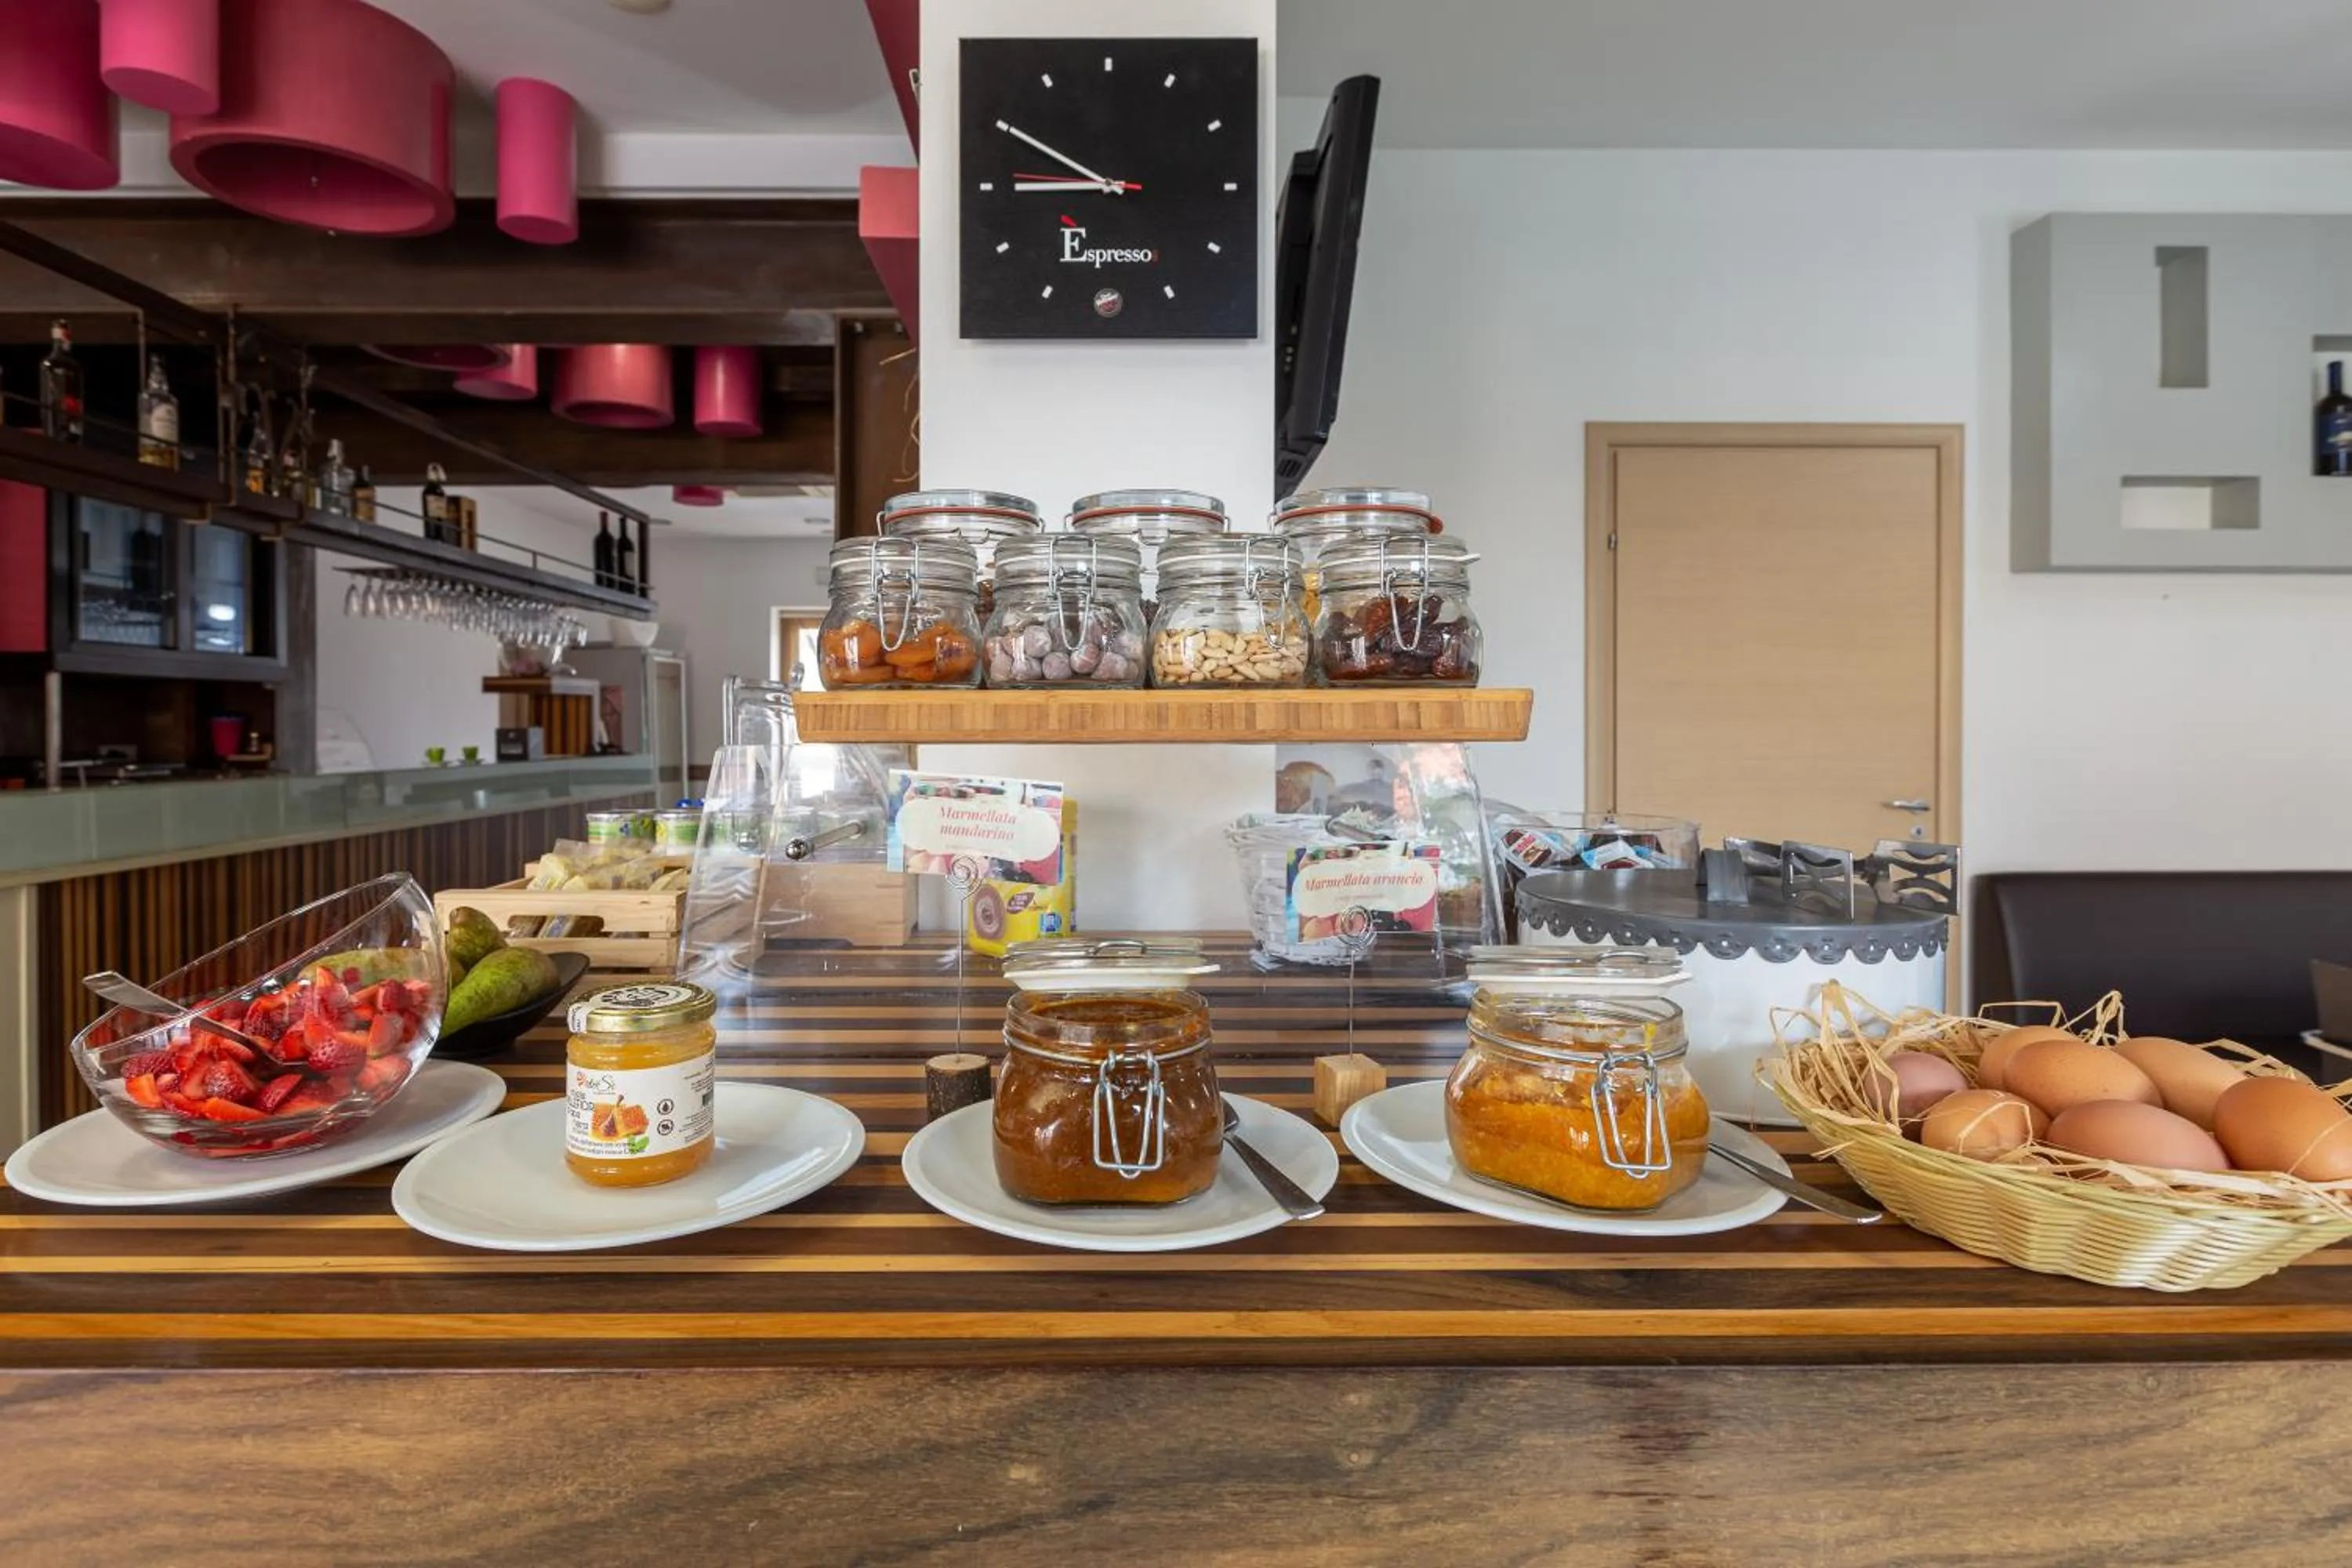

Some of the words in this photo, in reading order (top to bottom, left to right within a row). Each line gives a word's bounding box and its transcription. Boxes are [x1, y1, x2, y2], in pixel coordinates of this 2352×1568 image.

[940, 806, 1017, 824] Marmellata
[940, 824, 1014, 840] mandarino
[1305, 873, 1370, 891] Marmellata
[1374, 871, 1423, 885] arancia
